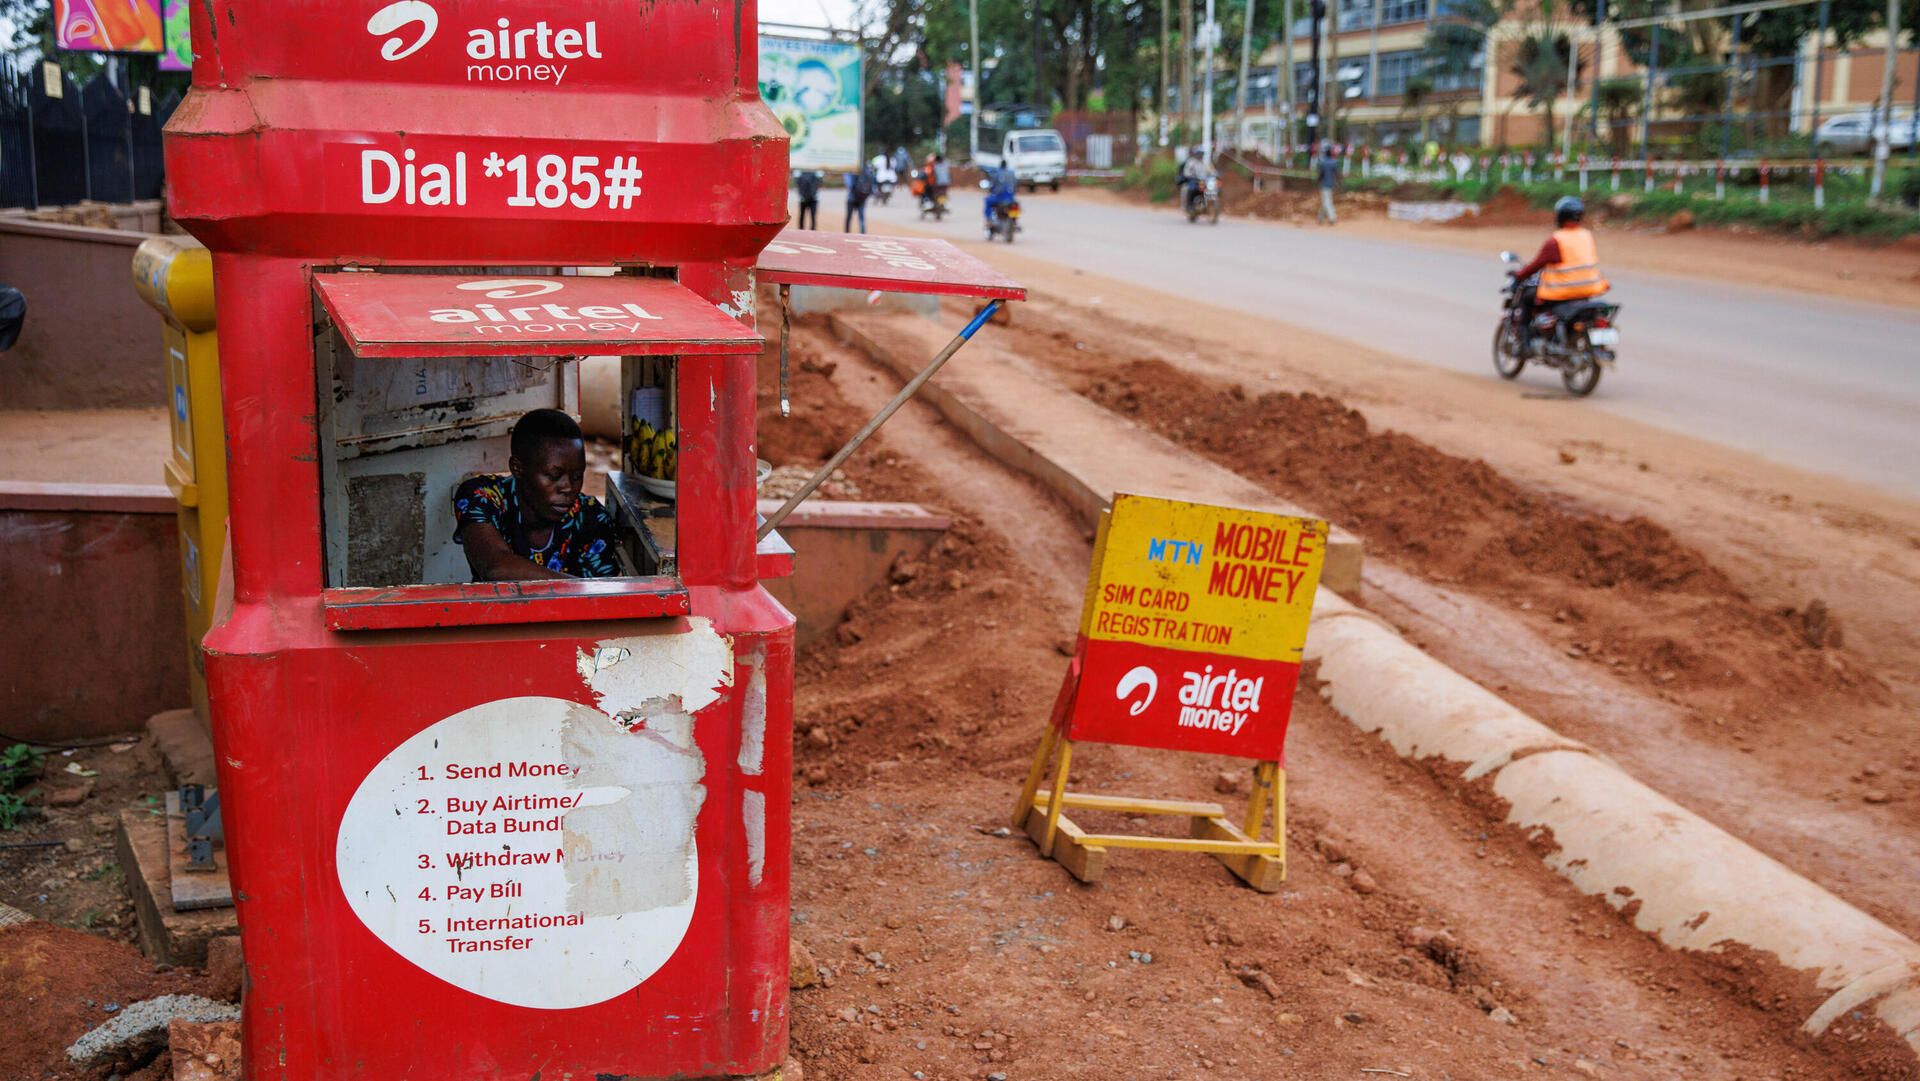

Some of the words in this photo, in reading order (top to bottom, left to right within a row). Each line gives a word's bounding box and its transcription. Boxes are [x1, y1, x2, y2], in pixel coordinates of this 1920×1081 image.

[467, 18, 603, 60] airtel
[467, 65, 568, 86] money
[361, 149, 467, 206] Dial
[429, 303, 663, 323] airtel
[474, 322, 641, 334] money
[1148, 538, 1203, 566] MTN
[1212, 522, 1316, 567] MOBILE
[1207, 561, 1304, 604] MONEY
[1103, 584, 1136, 605] SIM
[1139, 588, 1190, 612] CARD
[1097, 611, 1233, 645] REGISTRATION
[1178, 664, 1264, 712] airtel
[1178, 708, 1248, 736] money
[417, 765, 435, 781] 1.
[446, 763, 502, 780] Send
[417, 798, 436, 815] 2.
[447, 797, 488, 816] Buy
[492, 792, 584, 812] Airtime/
[447, 819, 497, 836] Data
[418, 854, 436, 870] 3.
[446, 850, 551, 868] Withdraw
[417, 887, 437, 902] 4.
[447, 885, 485, 903] Pay
[490, 882, 522, 899] Bill
[418, 919, 437, 934] 5.
[447, 911, 584, 932] International
[447, 935, 534, 953] Transfer
